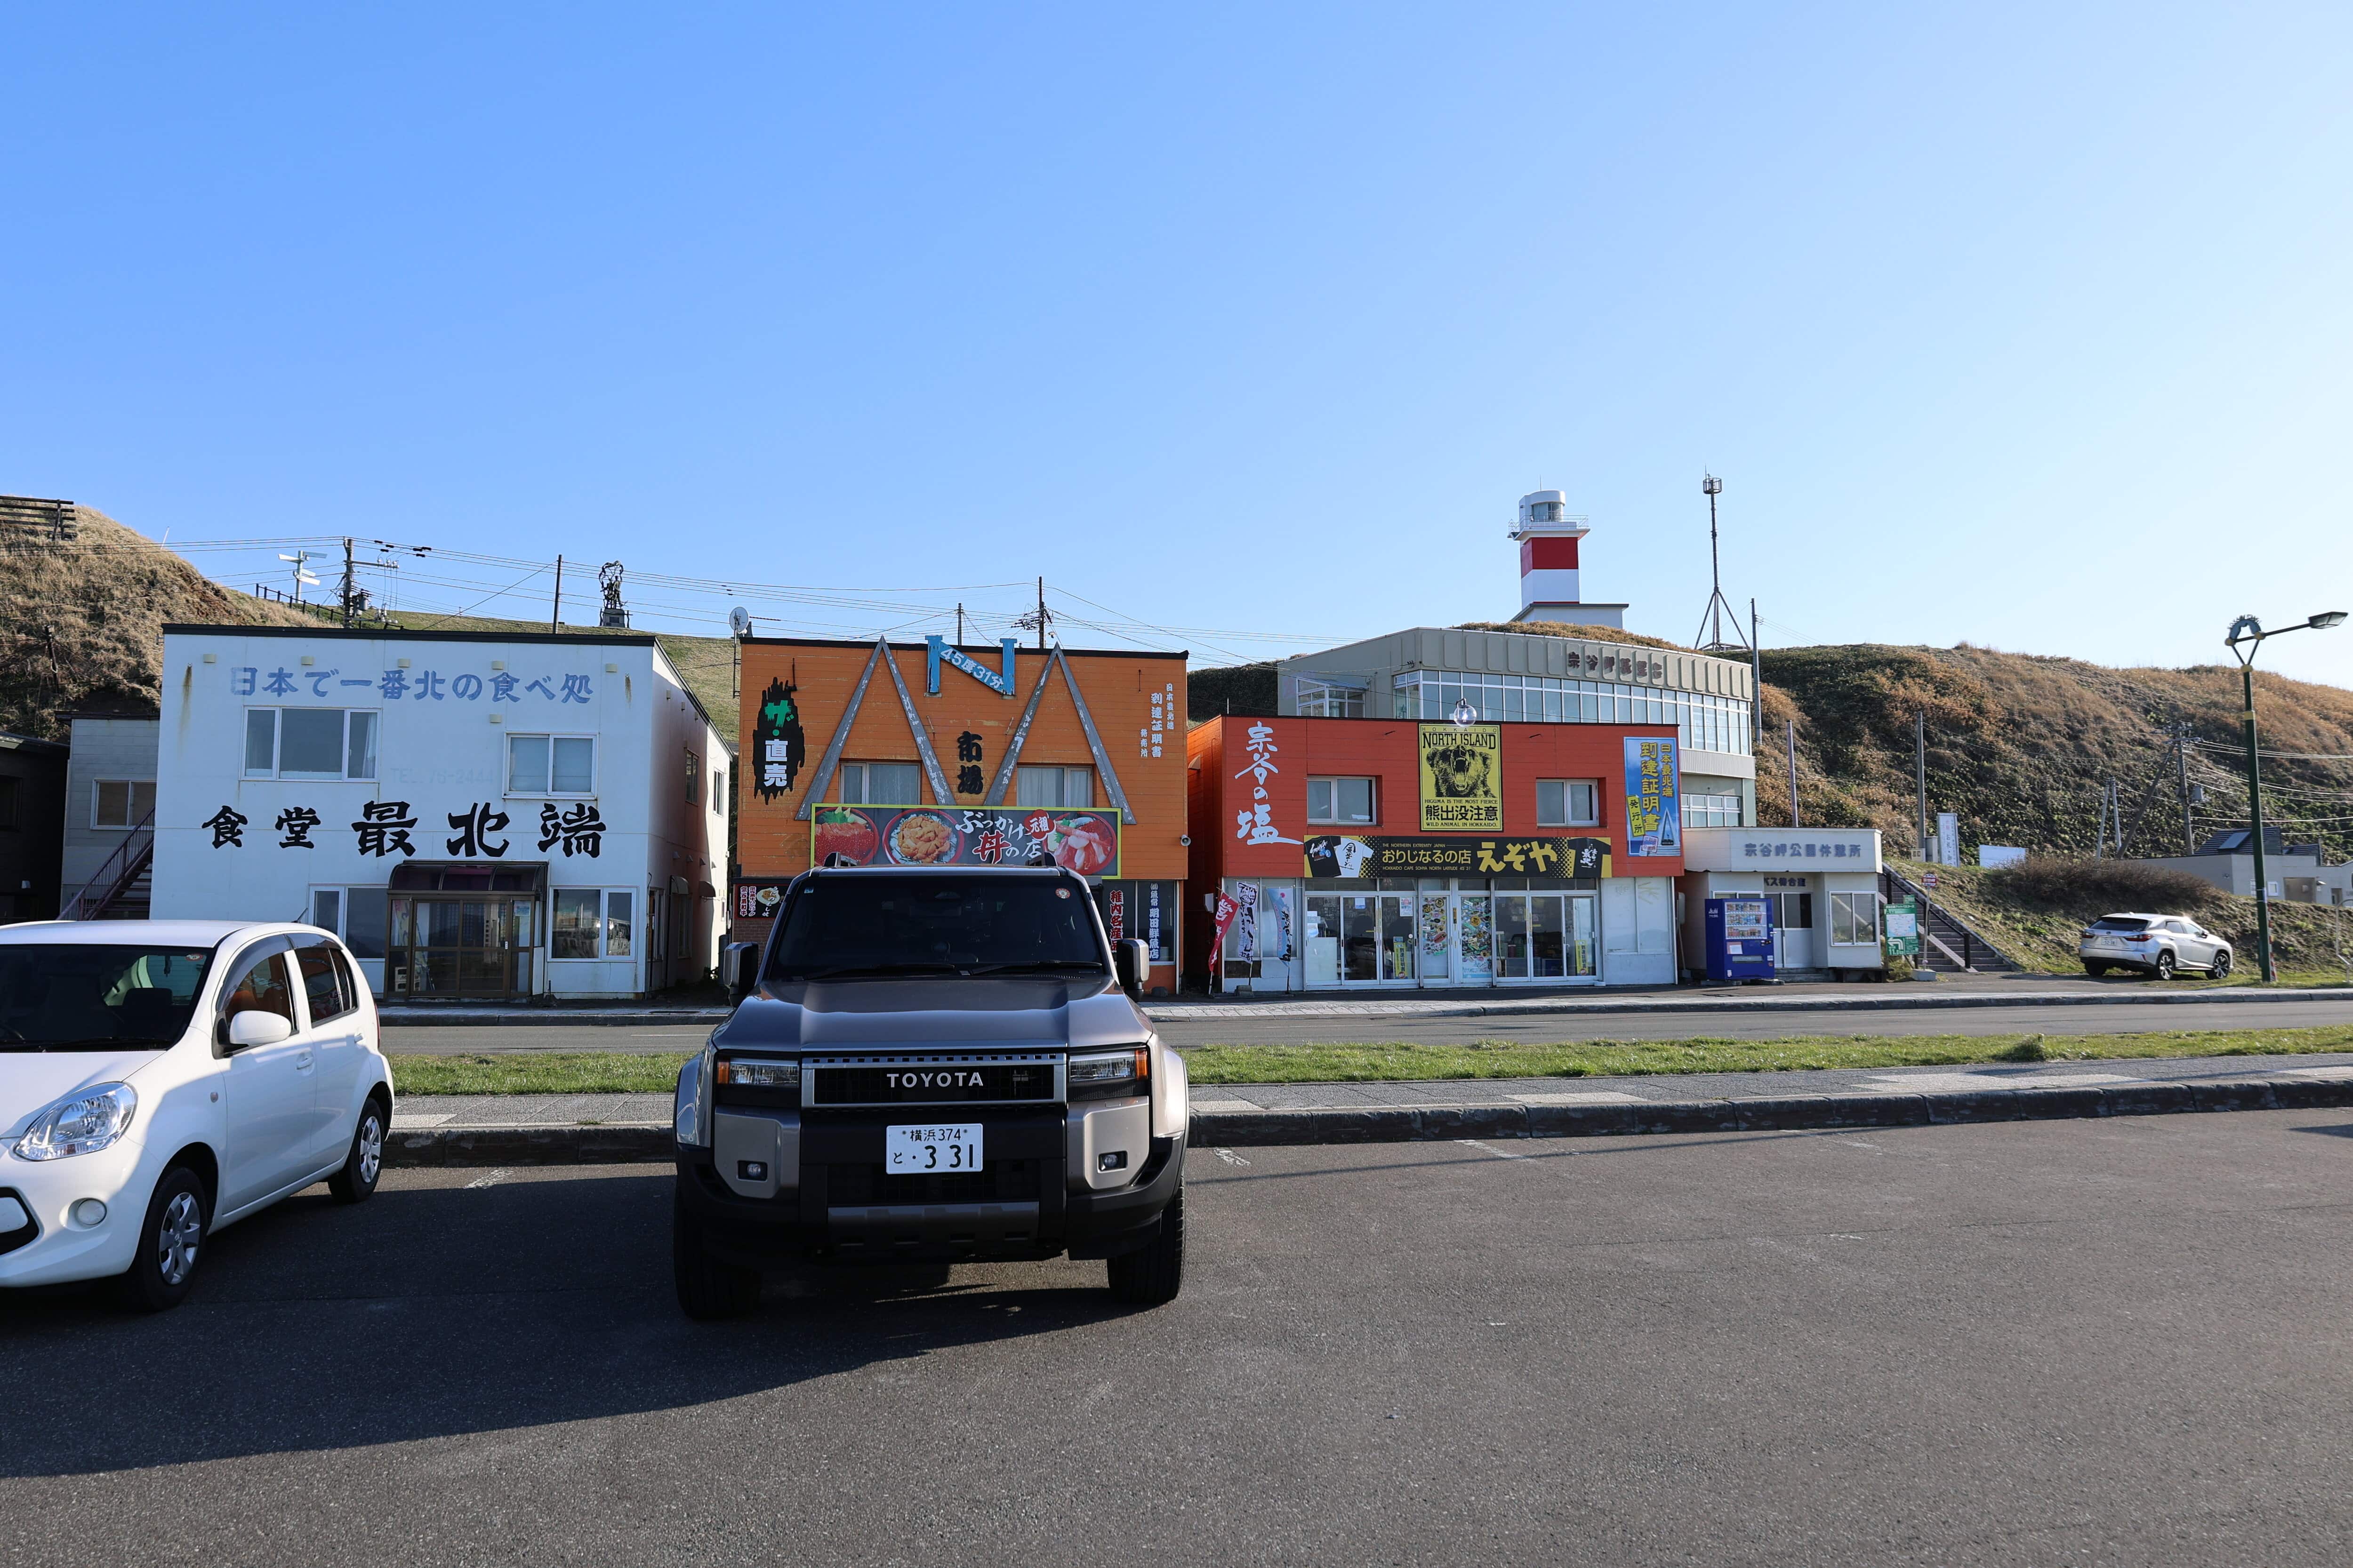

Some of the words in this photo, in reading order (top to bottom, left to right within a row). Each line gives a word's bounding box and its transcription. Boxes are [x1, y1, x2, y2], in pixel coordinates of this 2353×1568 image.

[231, 666, 593, 704] 日本で一番北の食べ処
[940, 648, 1004, 688] 45度31分
[1151, 692, 1163, 758] 到達証明書
[1422, 733, 1457, 749] NORTH
[1460, 734, 1496, 749] ISLAND
[764, 700, 794, 787] ザ・直売
[1235, 720, 1304, 845] 宗谷の塩
[1640, 742, 1661, 831] 到達証明書
[1661, 744, 1674, 797] 日本最北端
[955, 810, 1025, 840] ぶっかけ
[1030, 816, 1050, 833] 元祖
[1425, 805, 1498, 821] 熊出没注意
[1630, 800, 1643, 834] 発行所
[972, 830, 1042, 864] 丼の店
[1382, 849, 1471, 864] おりじなるの店
[1477, 841, 1558, 872] えぞや
[1745, 843, 1861, 857] 宗谷岬公園休憩所
[1149, 908, 1160, 959] 明田鮮魚店
[887, 1072, 983, 1088] TOYOTA
[894, 1152, 903, 1164] と
